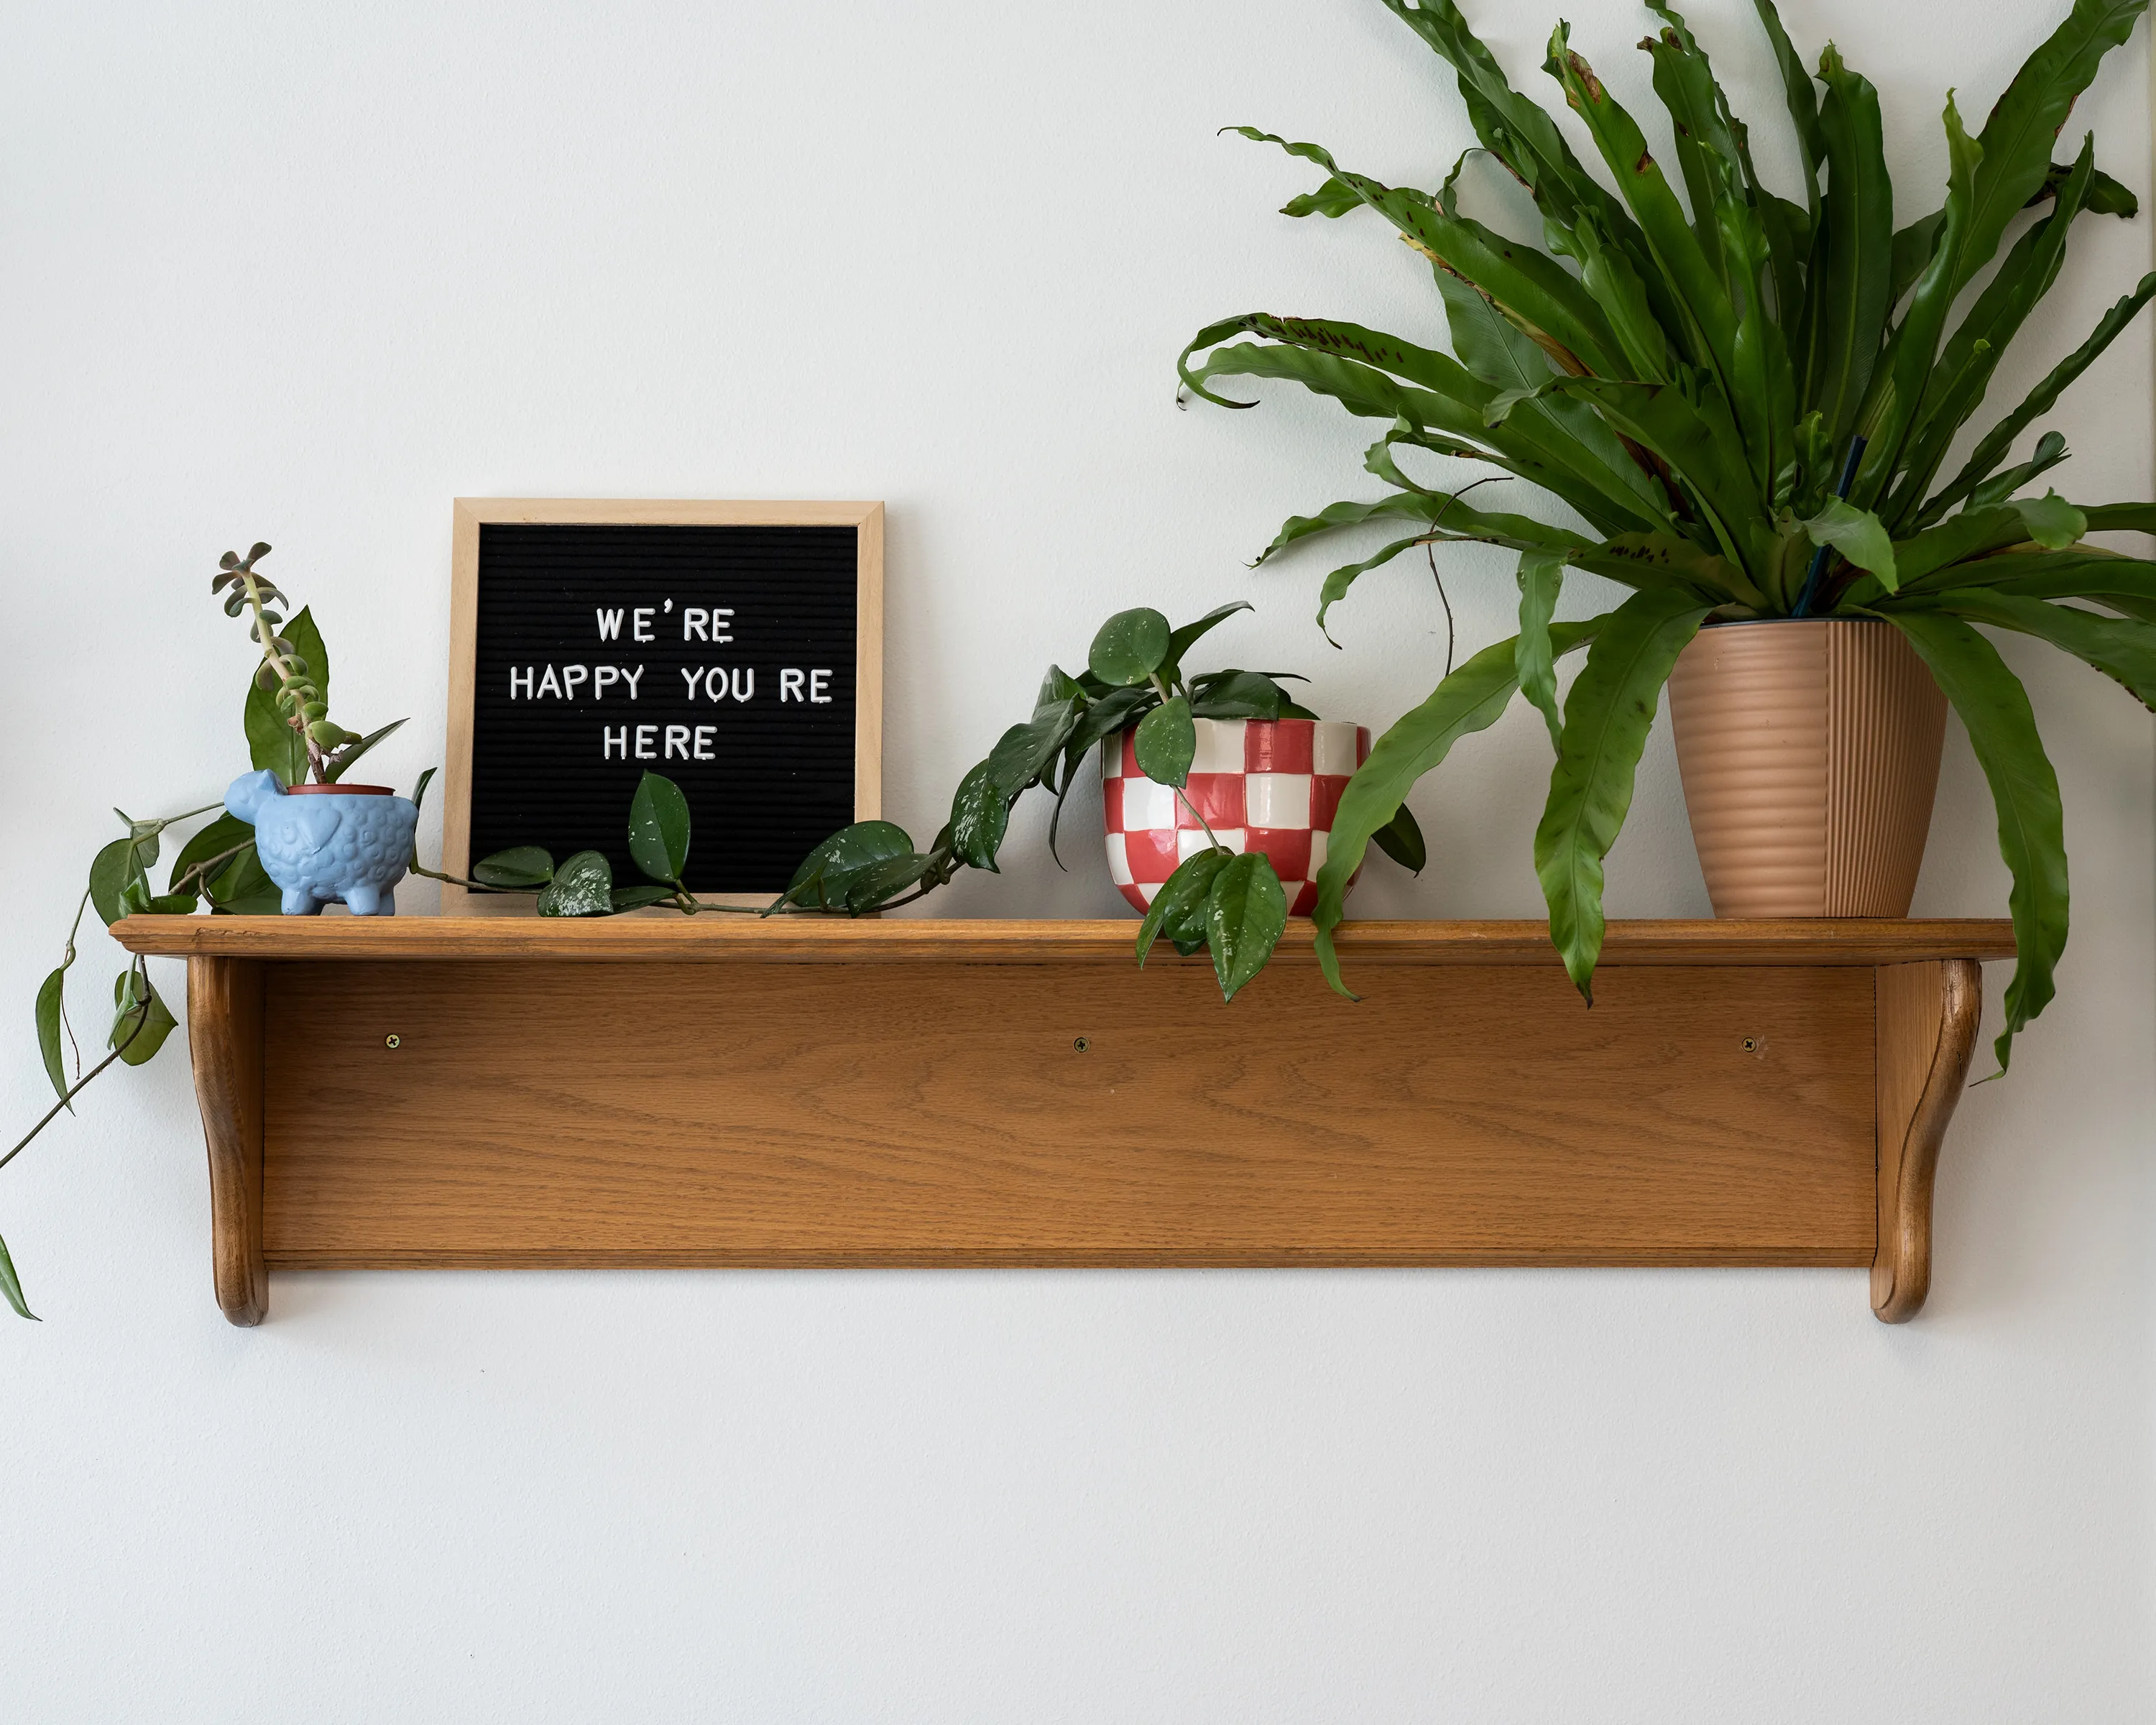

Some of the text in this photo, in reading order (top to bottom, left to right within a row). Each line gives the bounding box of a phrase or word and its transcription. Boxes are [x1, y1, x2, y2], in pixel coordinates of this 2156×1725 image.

[596, 598, 735, 644] WE'RE
[510, 663, 833, 704] HAPPY YOU RE
[604, 724, 718, 761] HERE
